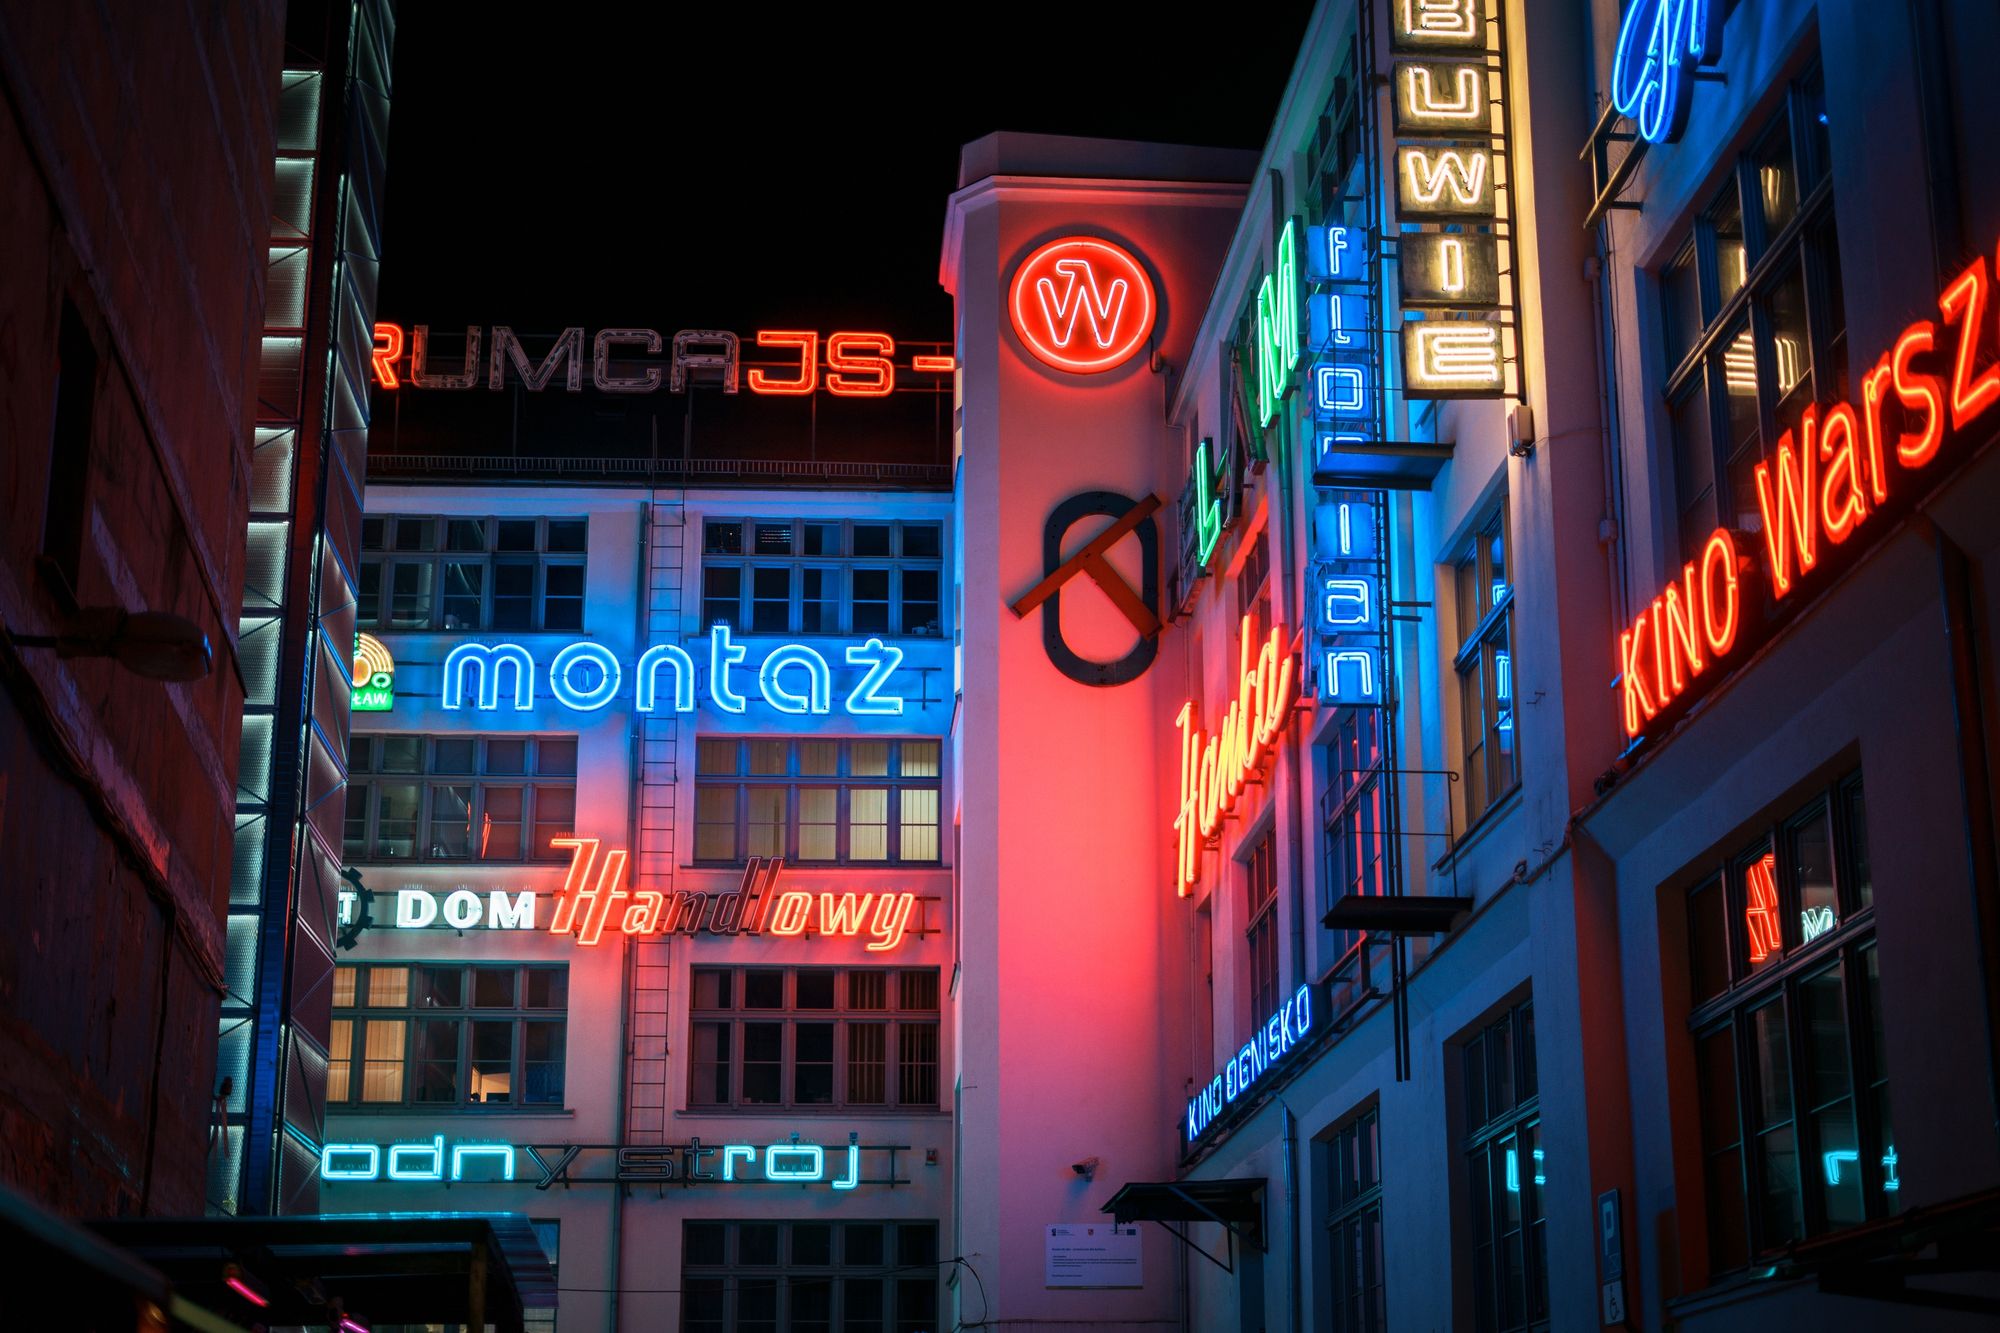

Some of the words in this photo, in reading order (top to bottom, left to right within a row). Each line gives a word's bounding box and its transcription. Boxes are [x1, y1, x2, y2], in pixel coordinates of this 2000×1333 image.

[1619, 527, 1740, 737] KINO
[1754, 233, 2000, 600] Warsz
[441, 623, 904, 715] montaż
[397, 890, 536, 929] DOM
[551, 838, 915, 952] Handlowy
[1188, 1074, 1222, 1142] KINO
[1226, 983, 1312, 1102] OGNISKO
